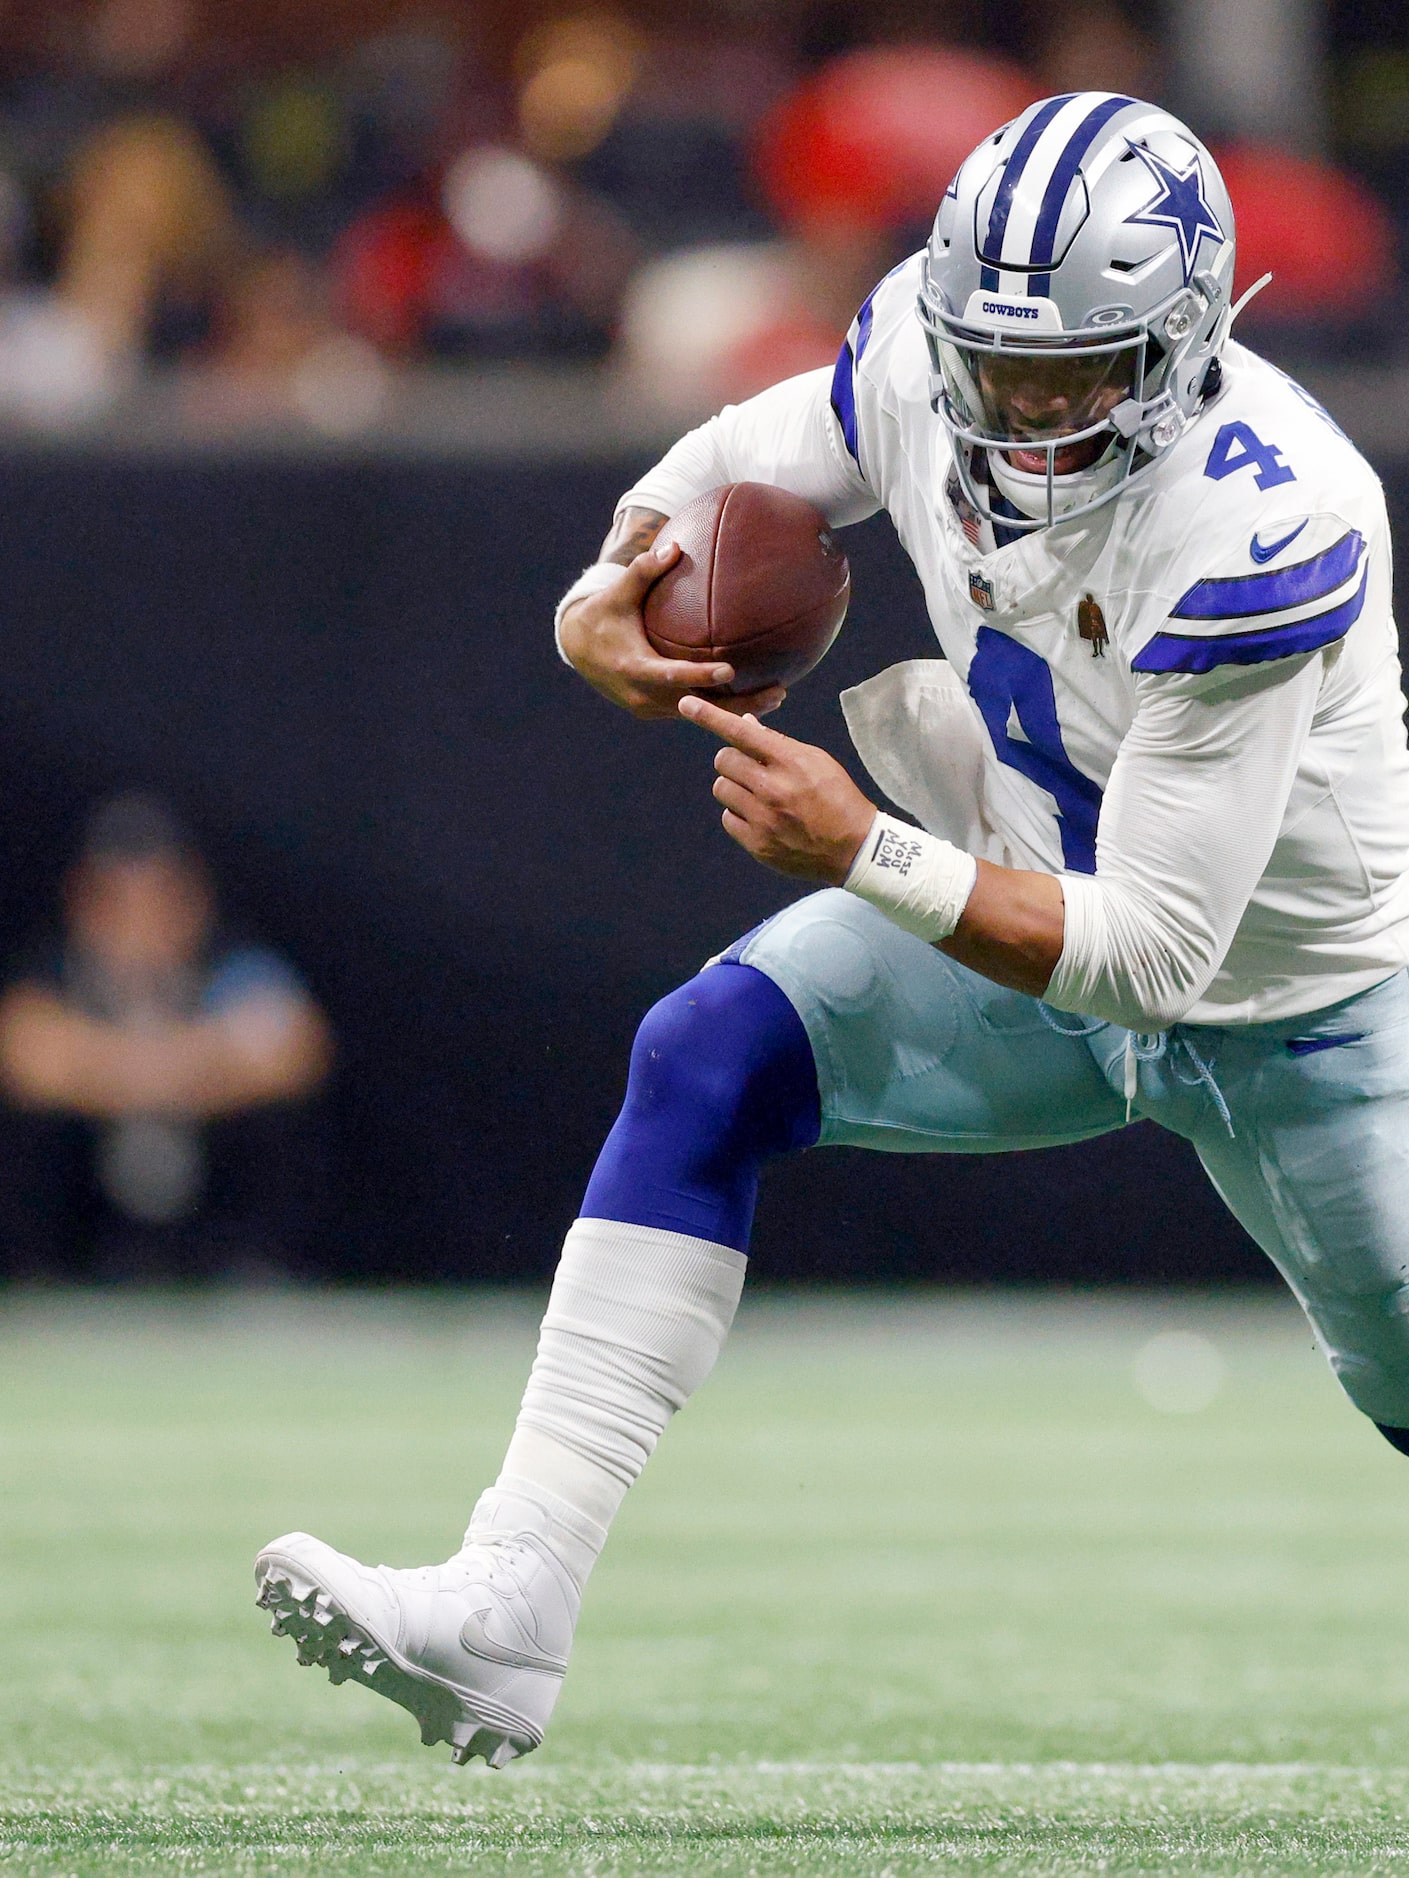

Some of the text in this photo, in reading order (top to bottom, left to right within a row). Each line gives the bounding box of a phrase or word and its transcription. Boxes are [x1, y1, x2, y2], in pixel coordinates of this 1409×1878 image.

[983, 302, 1039, 319] COWBOYS
[1203, 420, 1297, 492] 4
[968, 625, 1103, 874] 4
[876, 829, 900, 868] MOM
